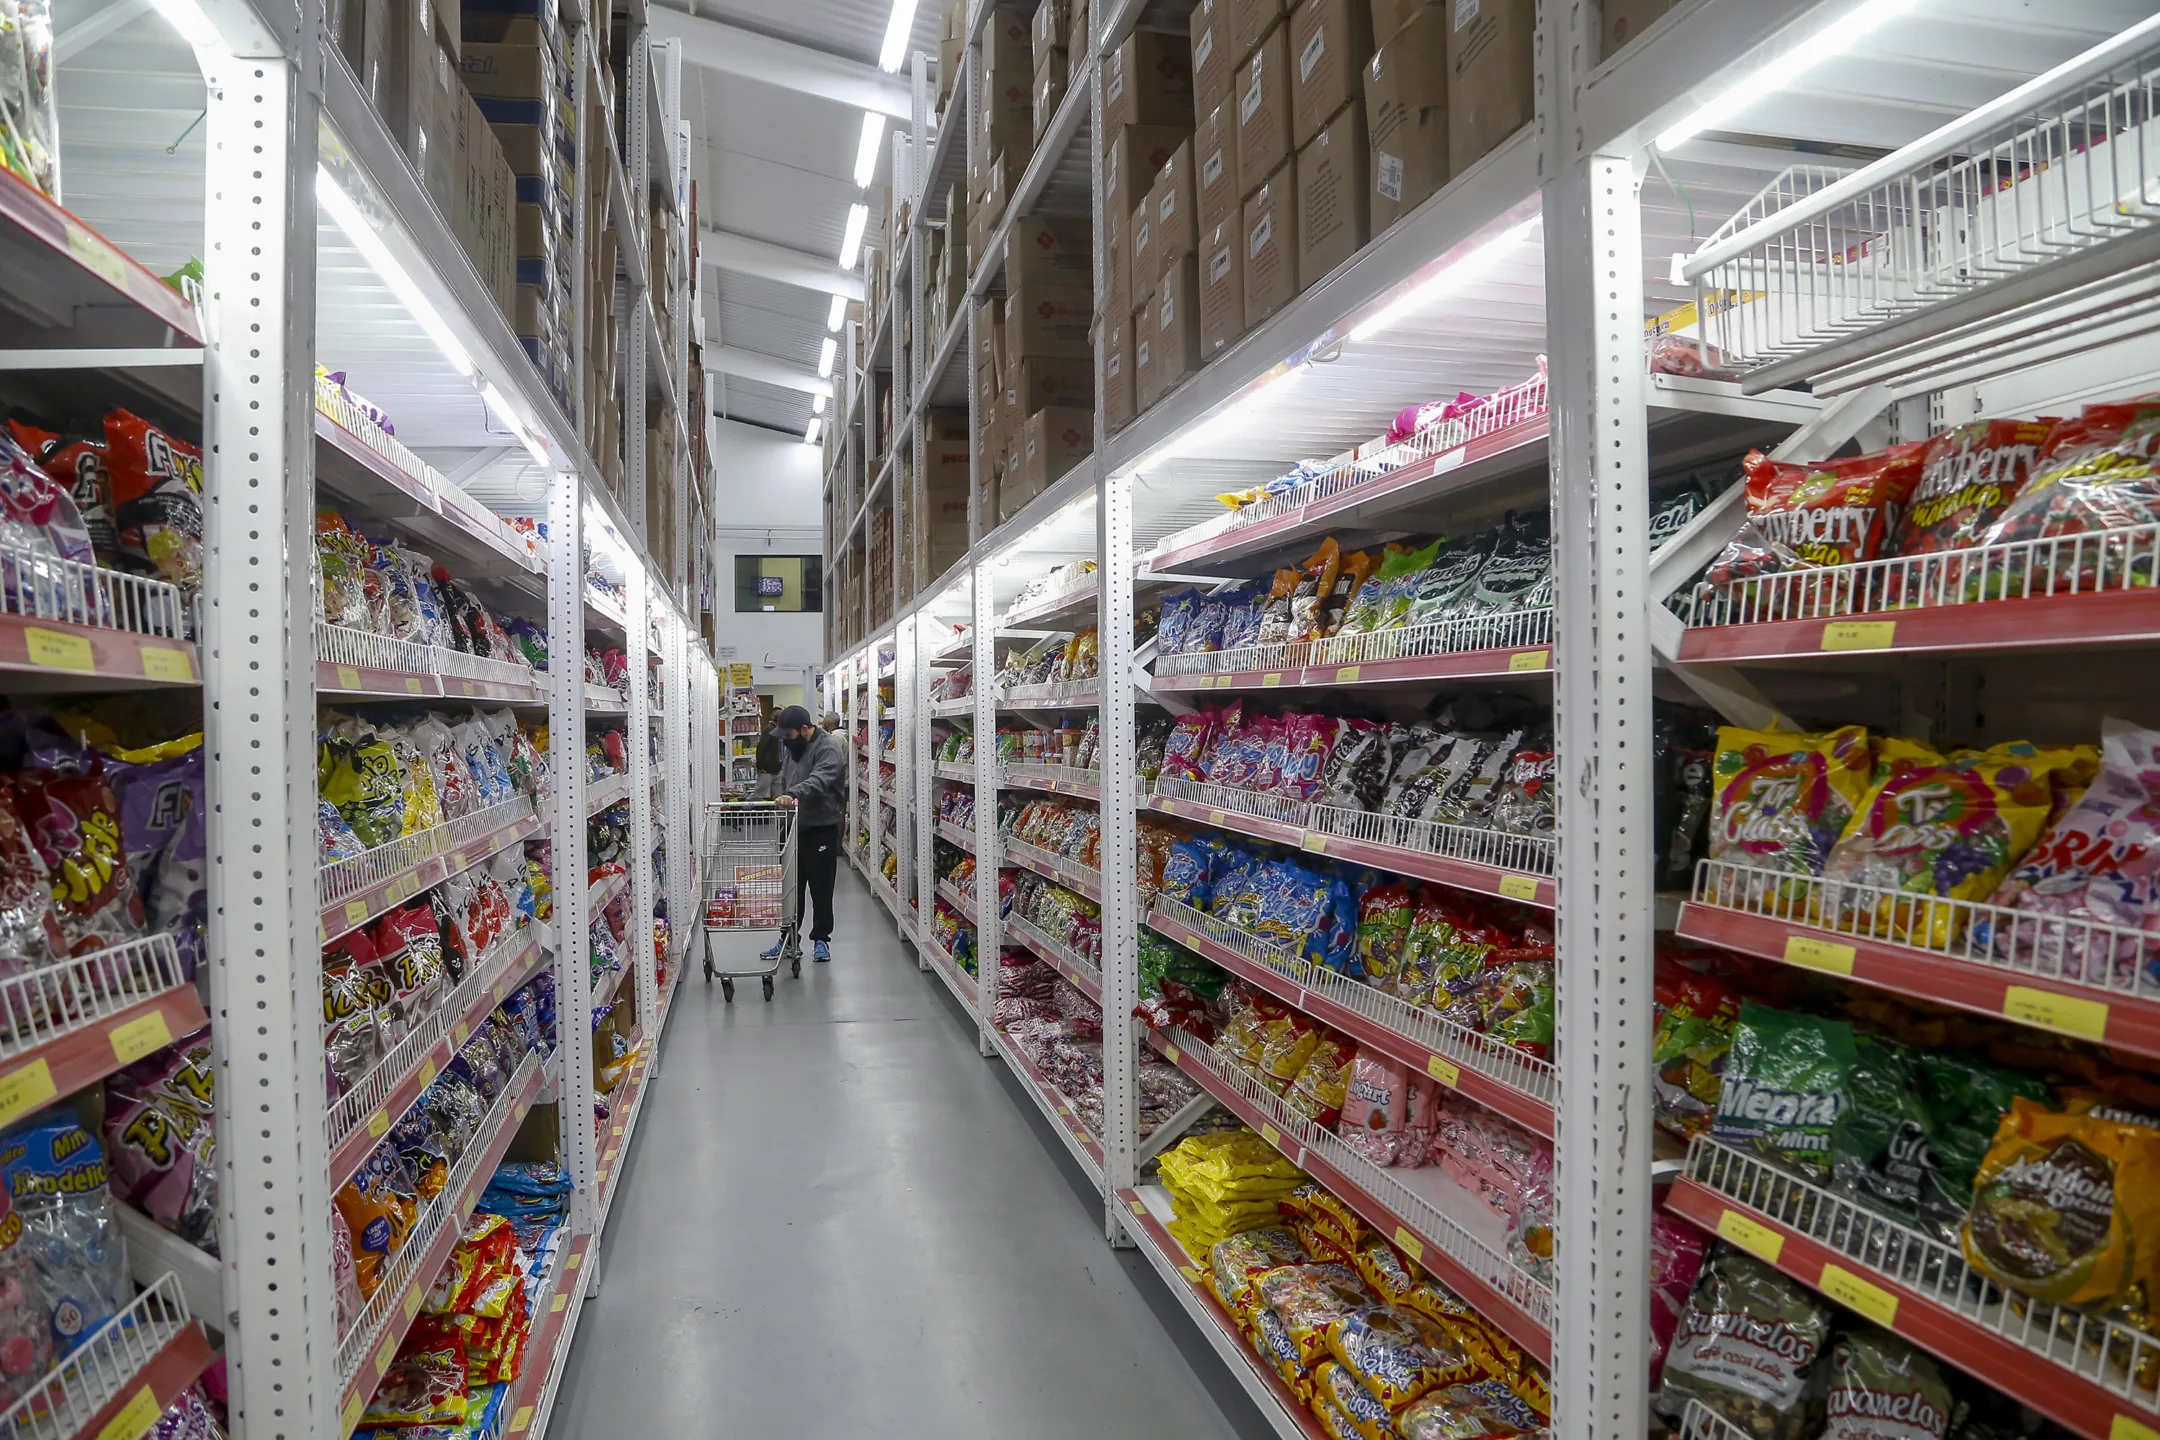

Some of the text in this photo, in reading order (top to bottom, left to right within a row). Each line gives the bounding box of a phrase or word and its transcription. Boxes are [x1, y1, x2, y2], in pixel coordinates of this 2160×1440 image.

[1716, 1078, 1840, 1127] Menta
[53, 1129, 88, 1162] Min
[1776, 1129, 1832, 1151] Mint
[1677, 1306, 1811, 1363] Caramelos
[1722, 1350, 1753, 1367] com
[1754, 1355, 1786, 1381] Leite
[1827, 1390, 1943, 1436] aramelos
